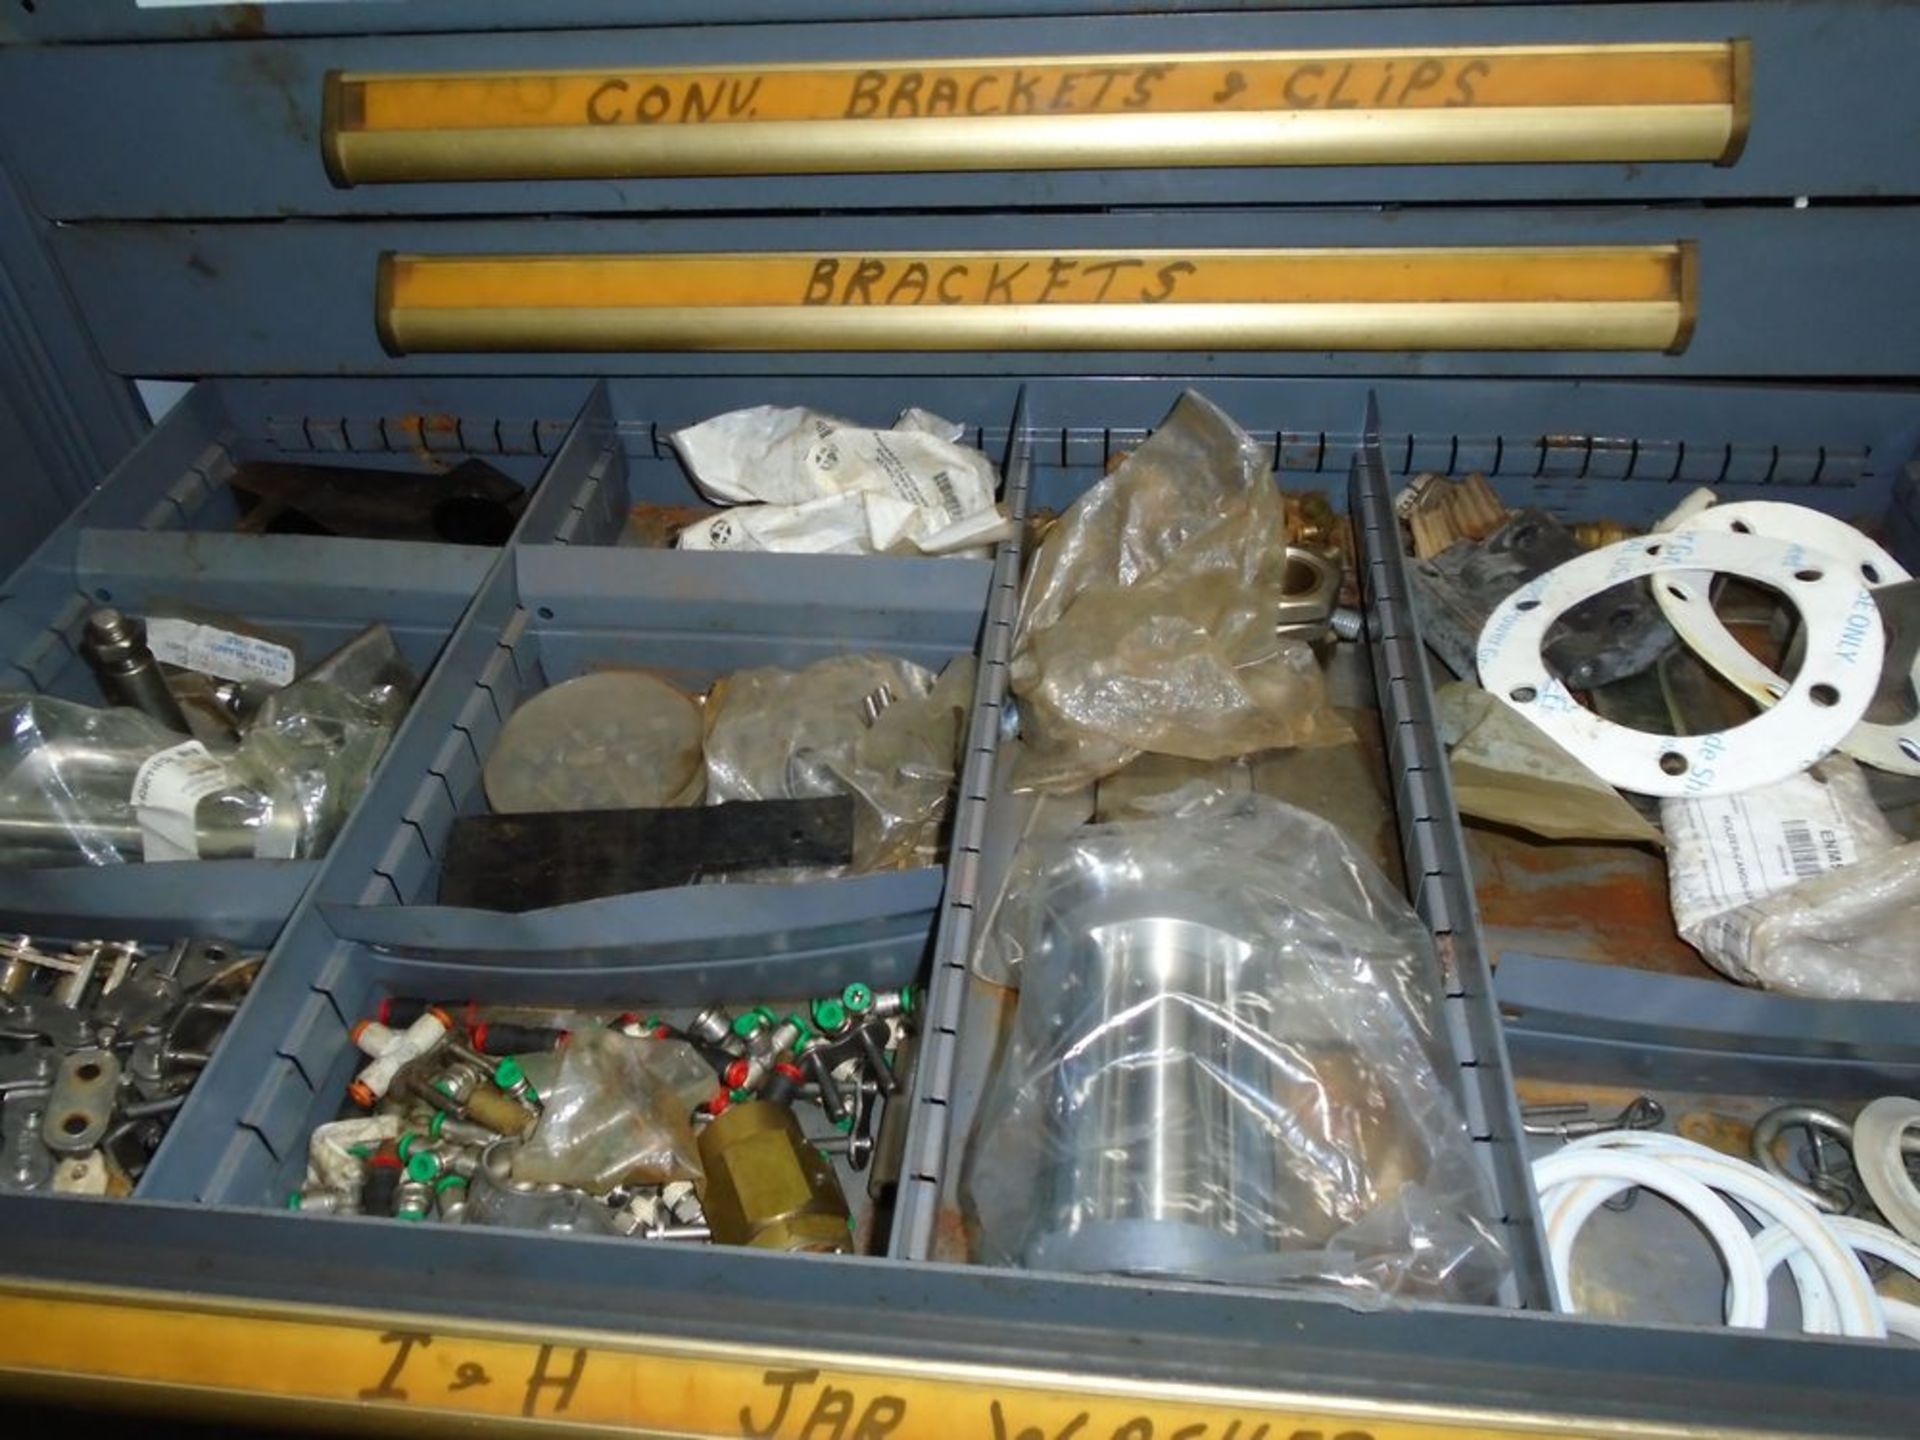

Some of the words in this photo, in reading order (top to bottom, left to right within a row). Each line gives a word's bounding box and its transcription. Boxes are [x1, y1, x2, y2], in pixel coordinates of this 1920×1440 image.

[587, 78, 759, 125] CONV.
[844, 64, 1174, 118] BRACKETS
[804, 258, 1196, 305] BRACKETS
[522, 1345, 587, 1417] H
[740, 1369, 907, 1440] JAR
